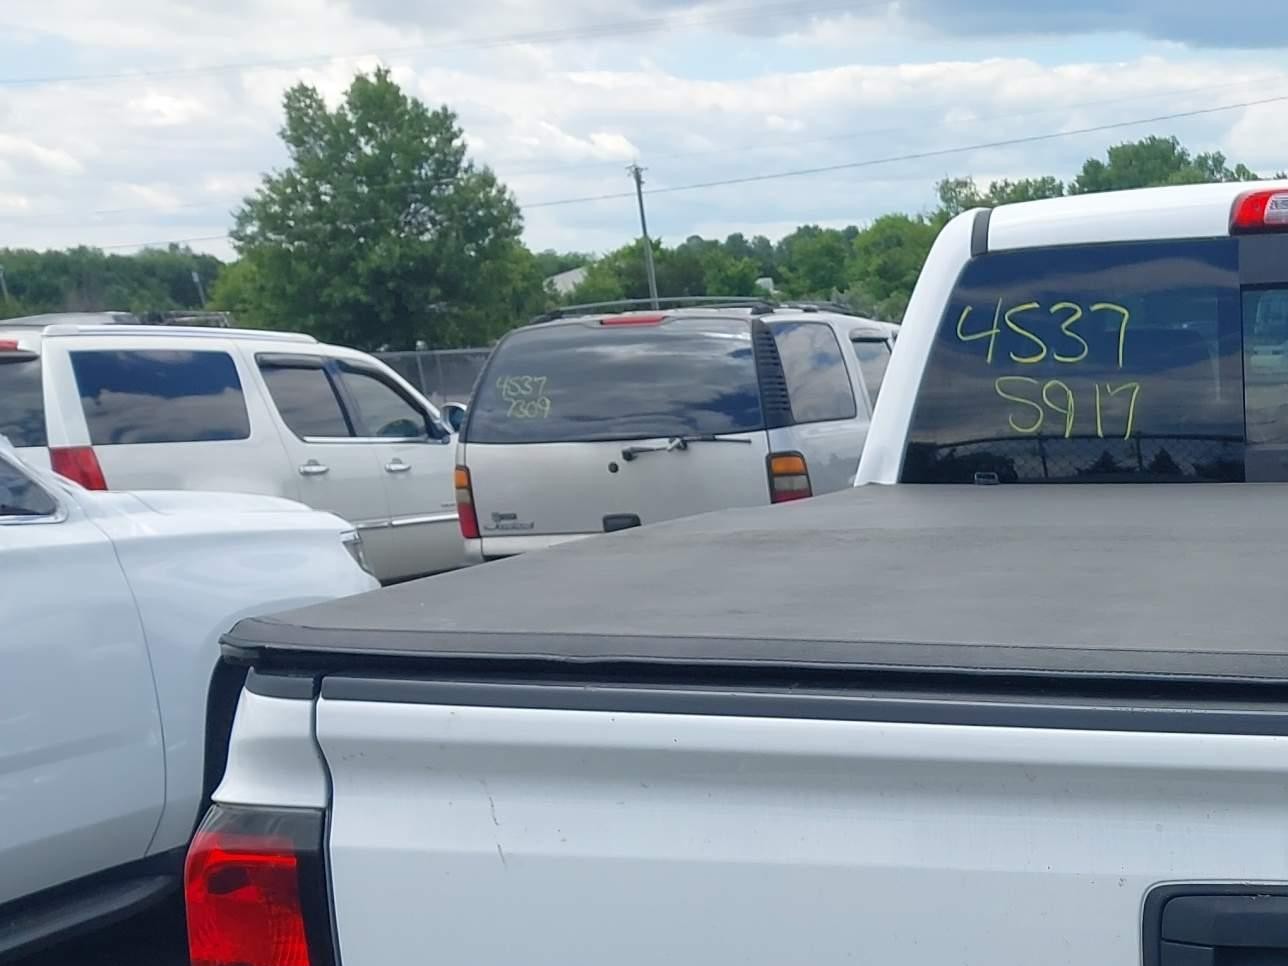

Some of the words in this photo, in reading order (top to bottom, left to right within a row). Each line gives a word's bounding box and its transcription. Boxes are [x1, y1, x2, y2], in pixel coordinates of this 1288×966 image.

[957, 298, 1129, 368] 4537
[495, 375, 547, 399] 4537
[995, 375, 1140, 440] 5917
